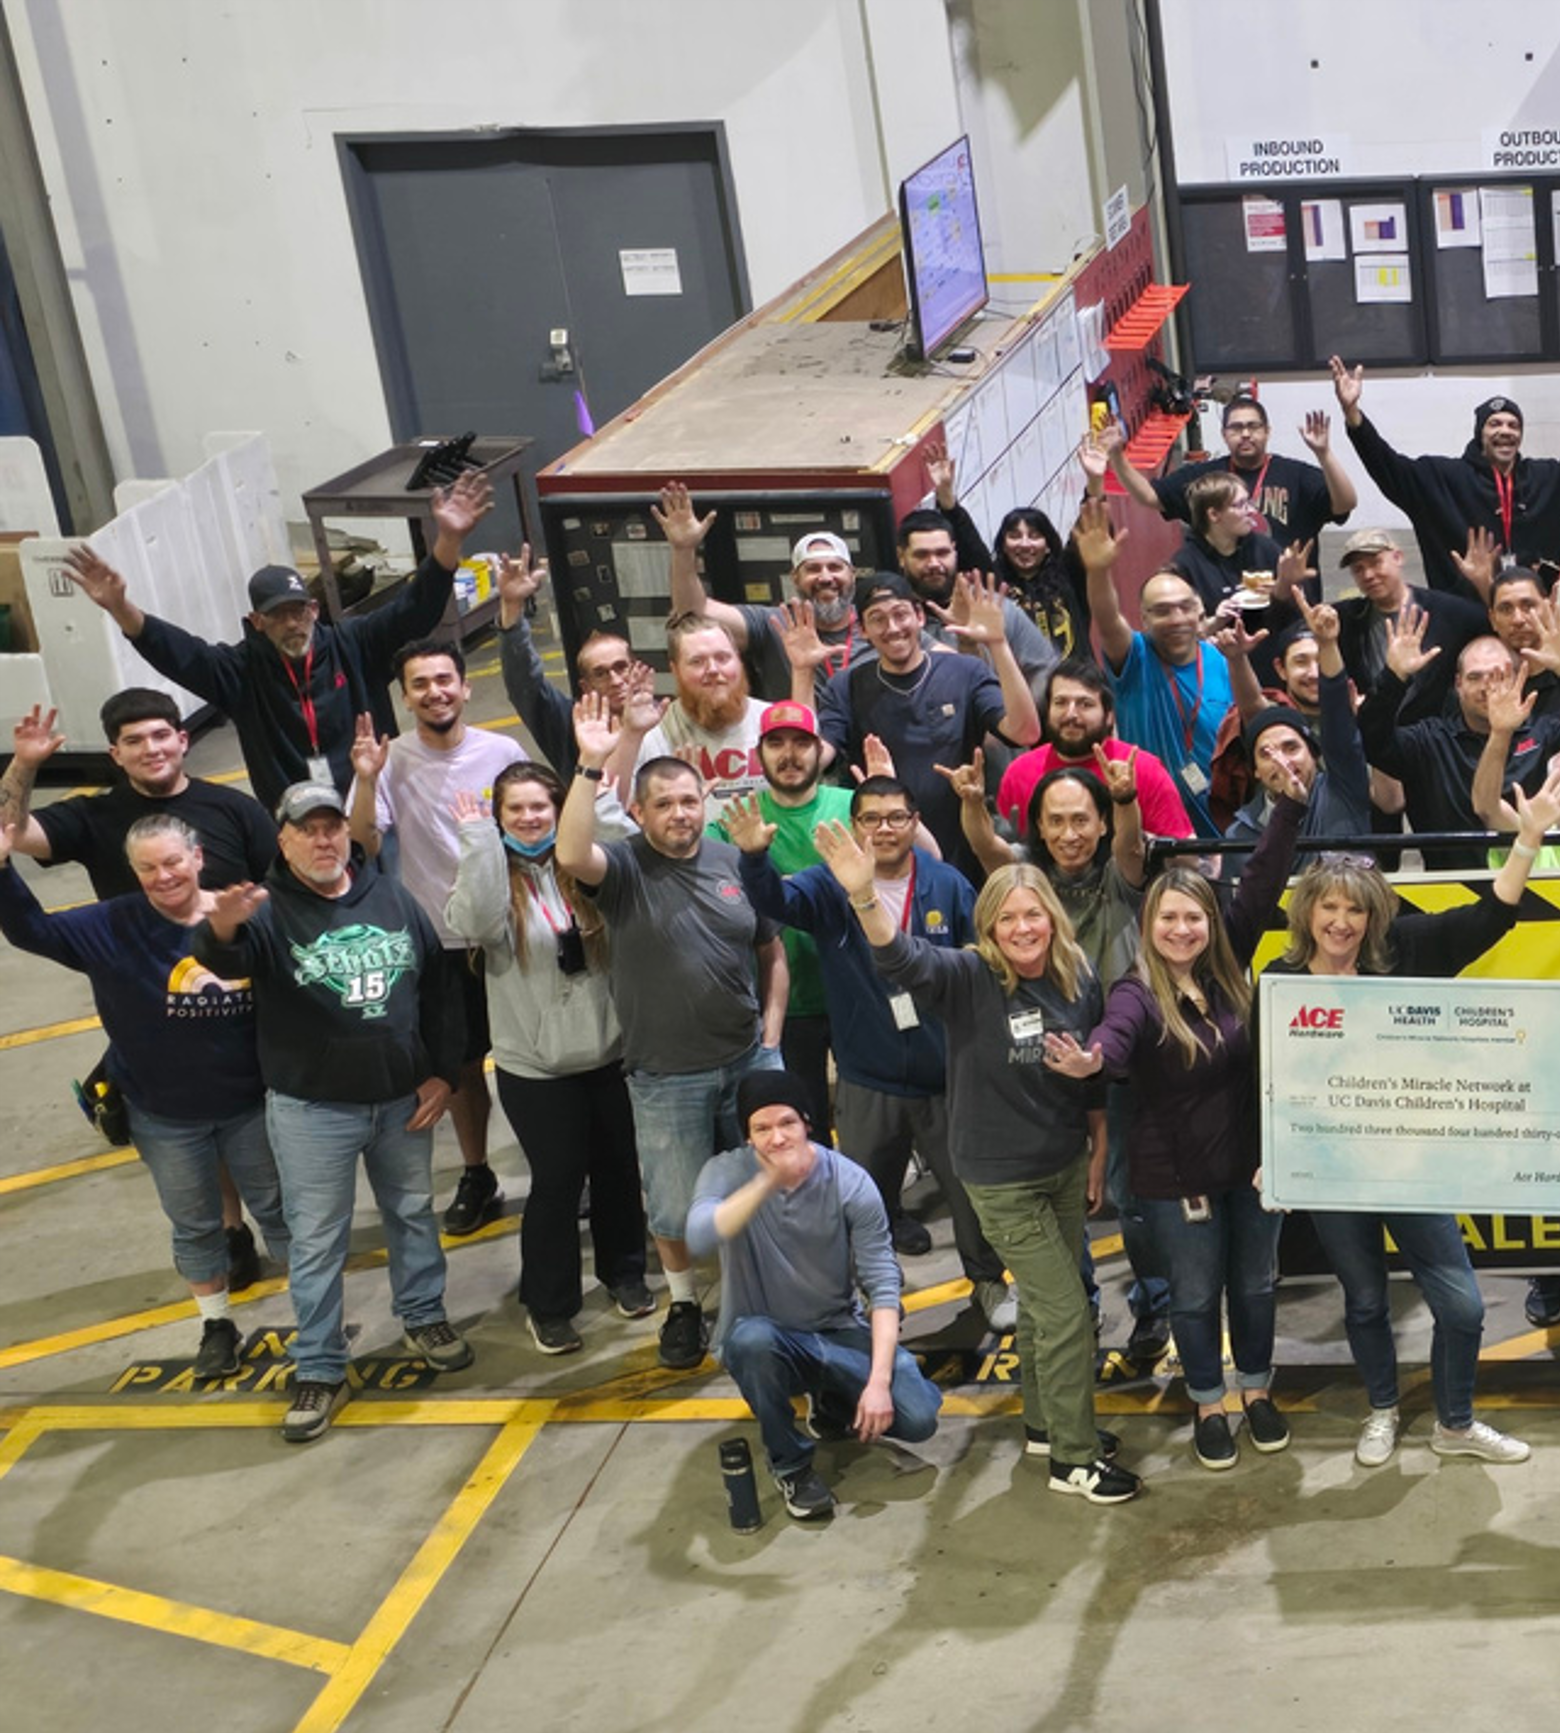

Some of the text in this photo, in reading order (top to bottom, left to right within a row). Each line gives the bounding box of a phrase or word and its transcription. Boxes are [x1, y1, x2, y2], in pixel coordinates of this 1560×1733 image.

[1252, 139, 1324, 156] INBOUND
[1239, 158, 1341, 178] PRODUCTION
[347, 971, 386, 1003] 15
[1289, 1005, 1345, 1029] ACE
[1406, 1006, 1441, 1015] DAVIS
[1454, 1006, 1515, 1017] CHILDREN'S
[1393, 1016, 1436, 1026] HEALTH
[1459, 1018, 1509, 1028] HOSPITAL
[1289, 1029, 1344, 1040] Hardware
[1327, 1076, 1532, 1093] Children's Miracle Network at
[1328, 1095, 1351, 1108] UC
[1354, 1096, 1392, 1109] Davis
[1395, 1096, 1465, 1110] Children's
[1468, 1098, 1527, 1114] Hospital
[1290, 1122, 1314, 1134] Two
[1316, 1122, 1362, 1135] hundred
[1364, 1124, 1393, 1136] three
[1395, 1124, 1446, 1137] thousand
[1447, 1126, 1471, 1138] four
[1473, 1127, 1519, 1139] hundred
[1513, 1171, 1533, 1184] Ace
